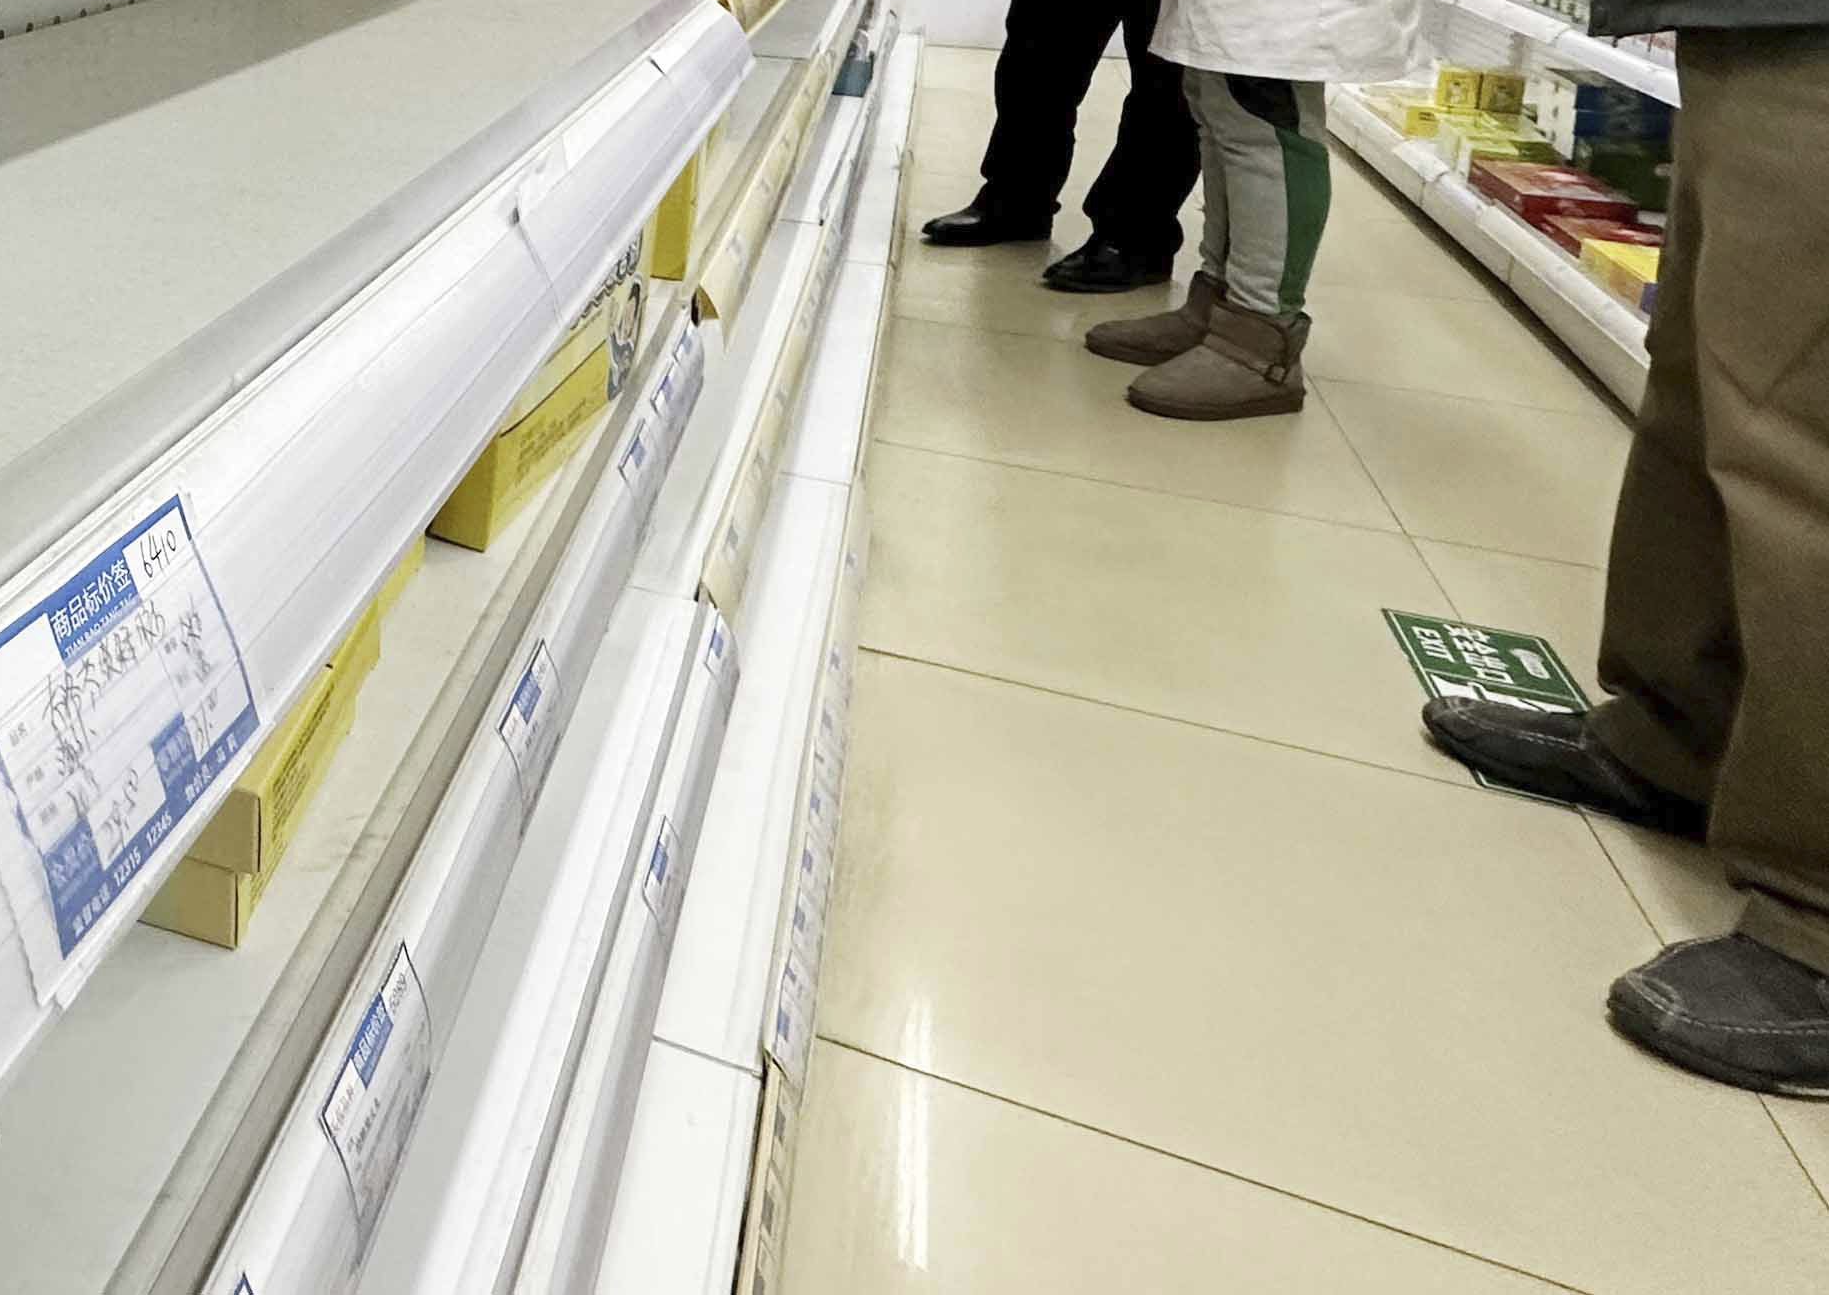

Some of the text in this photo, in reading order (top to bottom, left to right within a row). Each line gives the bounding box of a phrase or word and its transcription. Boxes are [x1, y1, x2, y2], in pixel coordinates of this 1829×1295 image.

[140, 530, 177, 579] 6410
[50, 559, 132, 644] 商品标价签
[1411, 625, 1455, 664] EXIT
[1442, 623, 1514, 685] 安全出口
